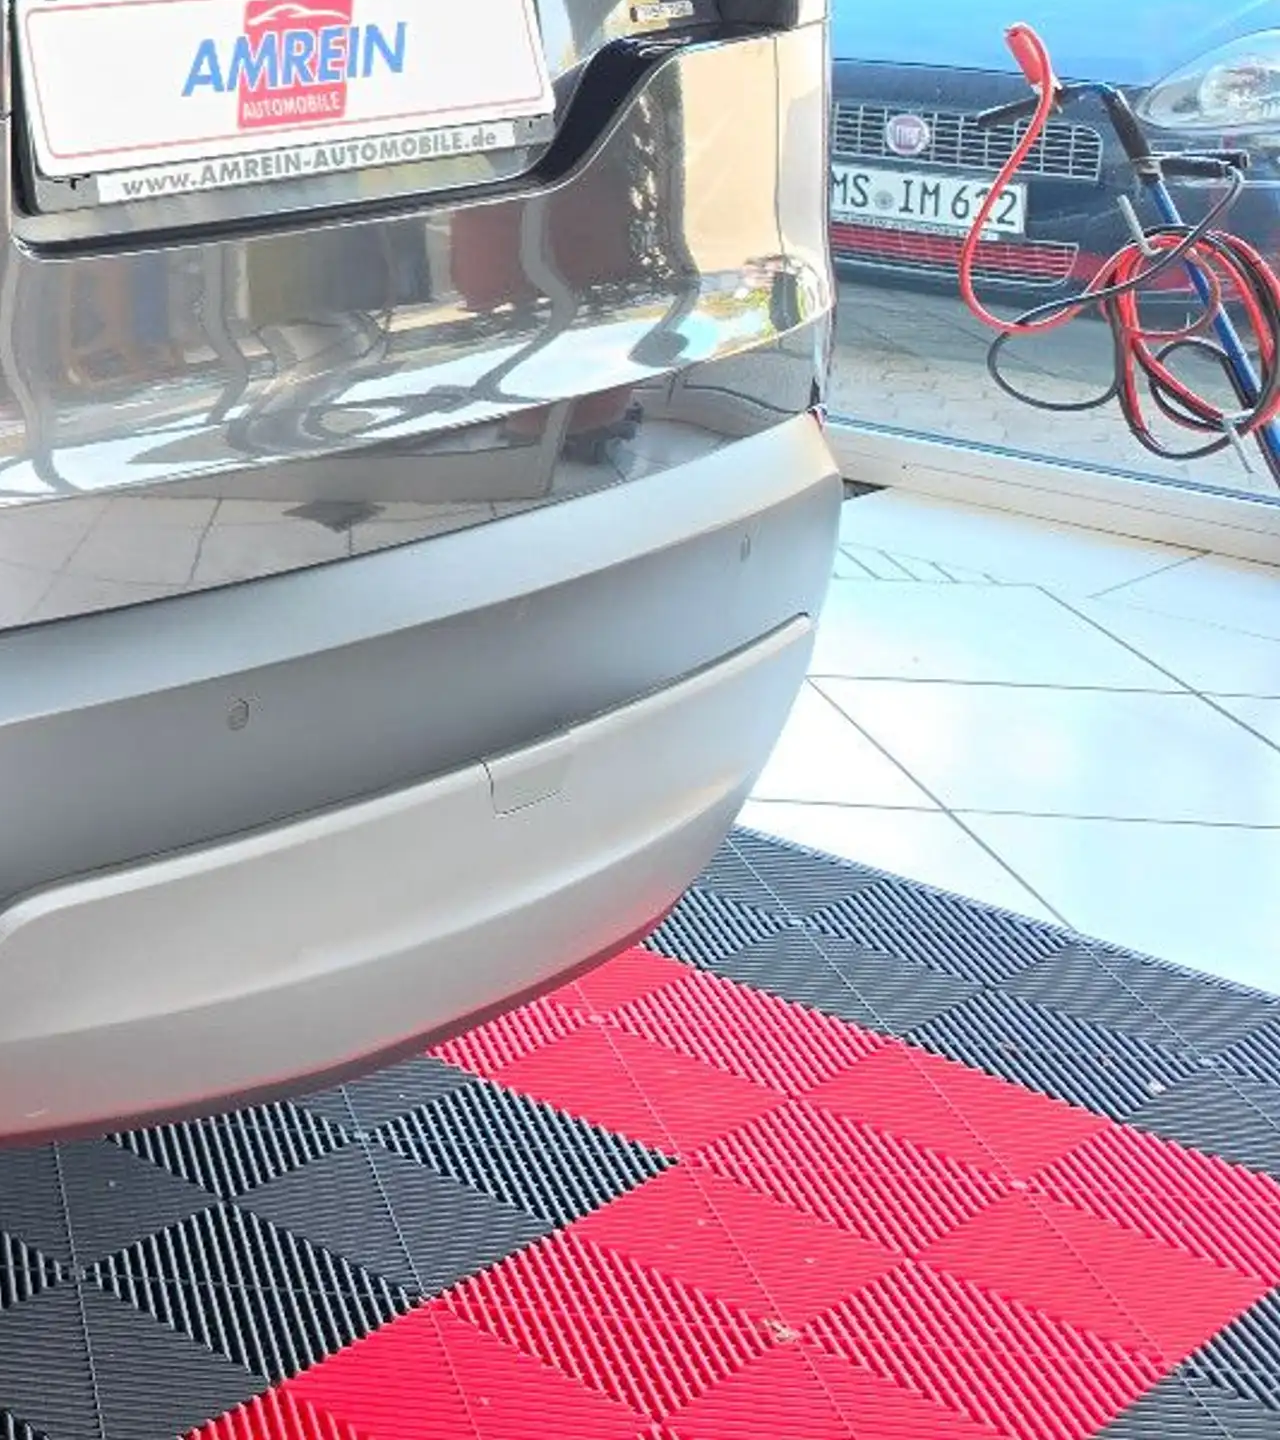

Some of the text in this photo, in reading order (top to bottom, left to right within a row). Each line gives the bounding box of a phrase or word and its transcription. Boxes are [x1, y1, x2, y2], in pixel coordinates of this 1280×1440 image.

[181, 21, 407, 98] AMREIN
[242, 90, 341, 121] AUTOMOBILE
[121, 126, 498, 198] www.AMREIN-AUTOMOBILE.de
[830, 171, 870, 208] MS
[898, 179, 941, 217] IM
